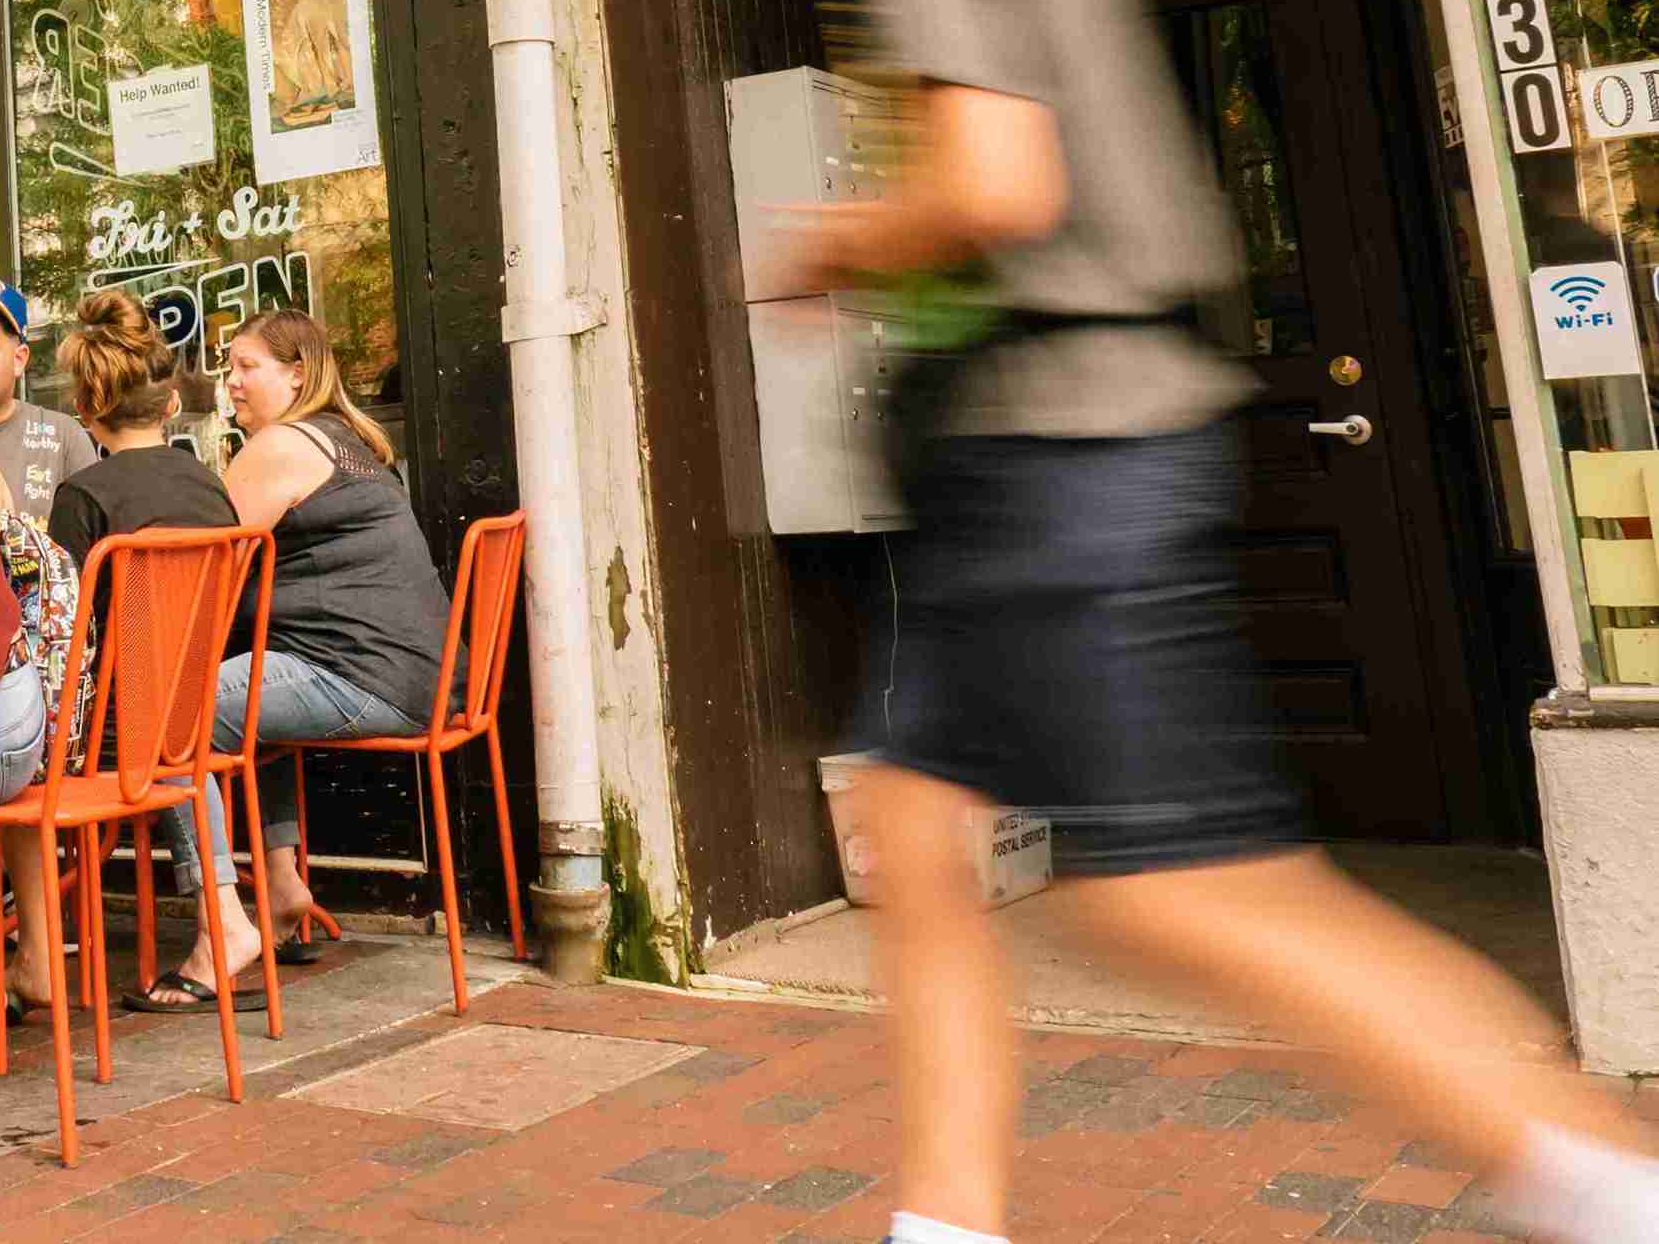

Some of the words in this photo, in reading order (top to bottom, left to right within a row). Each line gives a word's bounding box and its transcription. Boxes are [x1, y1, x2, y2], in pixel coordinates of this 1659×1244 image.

[119, 87, 147, 104] Help
[150, 75, 202, 97] Wanted!
[90, 200, 172, 259] Fri
[217, 186, 302, 241] Sat
[82, 251, 314, 376] PEN
[1555, 311, 1613, 330] Wi-Fi
